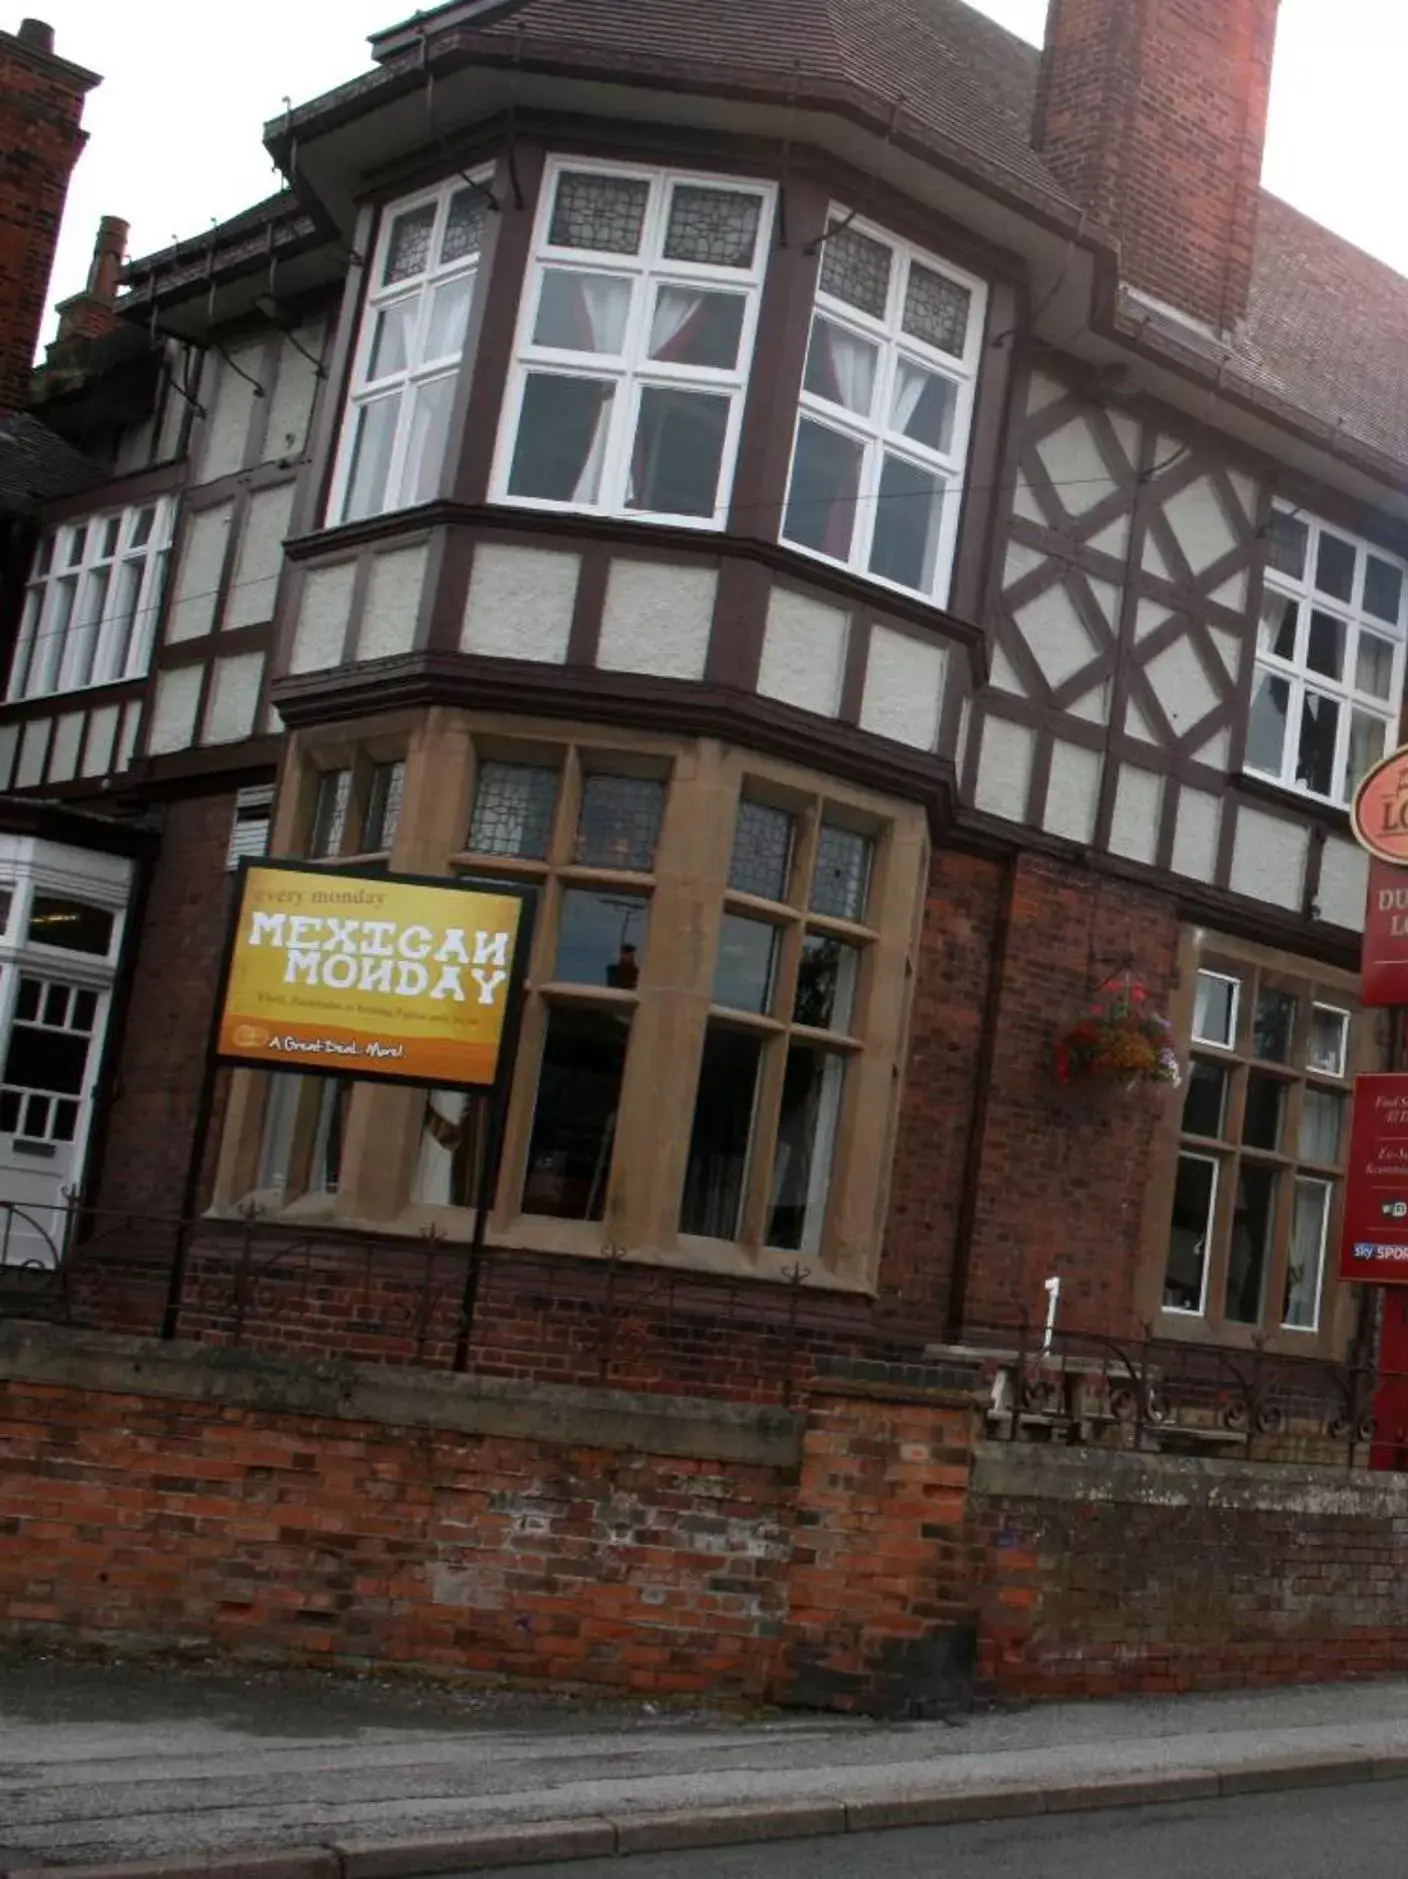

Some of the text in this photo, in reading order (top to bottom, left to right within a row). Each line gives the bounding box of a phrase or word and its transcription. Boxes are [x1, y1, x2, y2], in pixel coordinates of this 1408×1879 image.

[254, 888, 388, 907] every monday
[248, 911, 510, 965] MEXICAN
[283, 949, 507, 1005] MONDAY
[268, 1036, 281, 1050] A
[1354, 1243, 1373, 1260] sky
